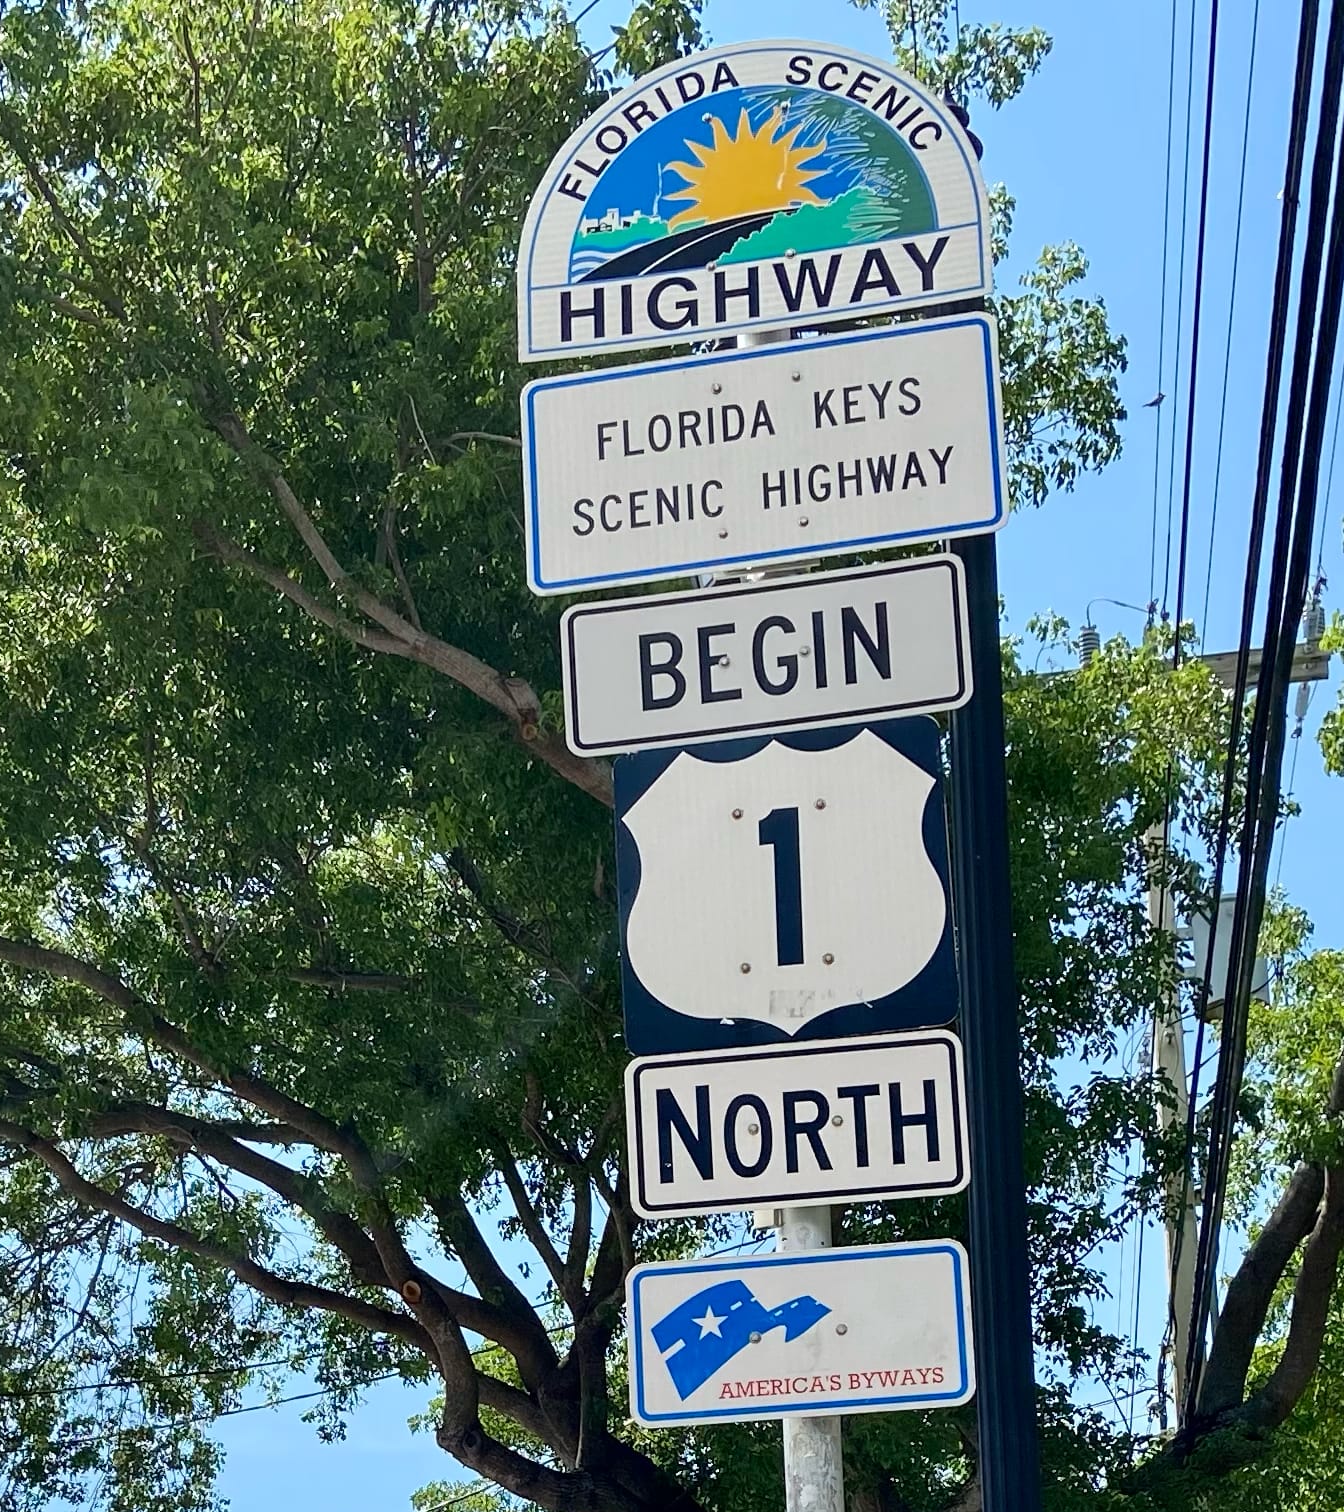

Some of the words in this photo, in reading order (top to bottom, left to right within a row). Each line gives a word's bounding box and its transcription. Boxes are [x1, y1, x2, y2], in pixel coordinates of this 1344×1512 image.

[559, 60, 740, 203] FLORIDA
[786, 54, 943, 153] SCENIC
[560, 235, 951, 343] HIGHWAY
[597, 398, 777, 461] FLORIDA
[813, 376, 922, 431] KEYS
[572, 478, 725, 537] SCENIC
[761, 445, 956, 510] HIGHWAY
[637, 601, 893, 713] BEGIN
[757, 805, 805, 968] 1
[655, 1078, 942, 1185] NORTH
[718, 1373, 843, 1401] AMERICA'S
[847, 1366, 945, 1392] BYWAYS
